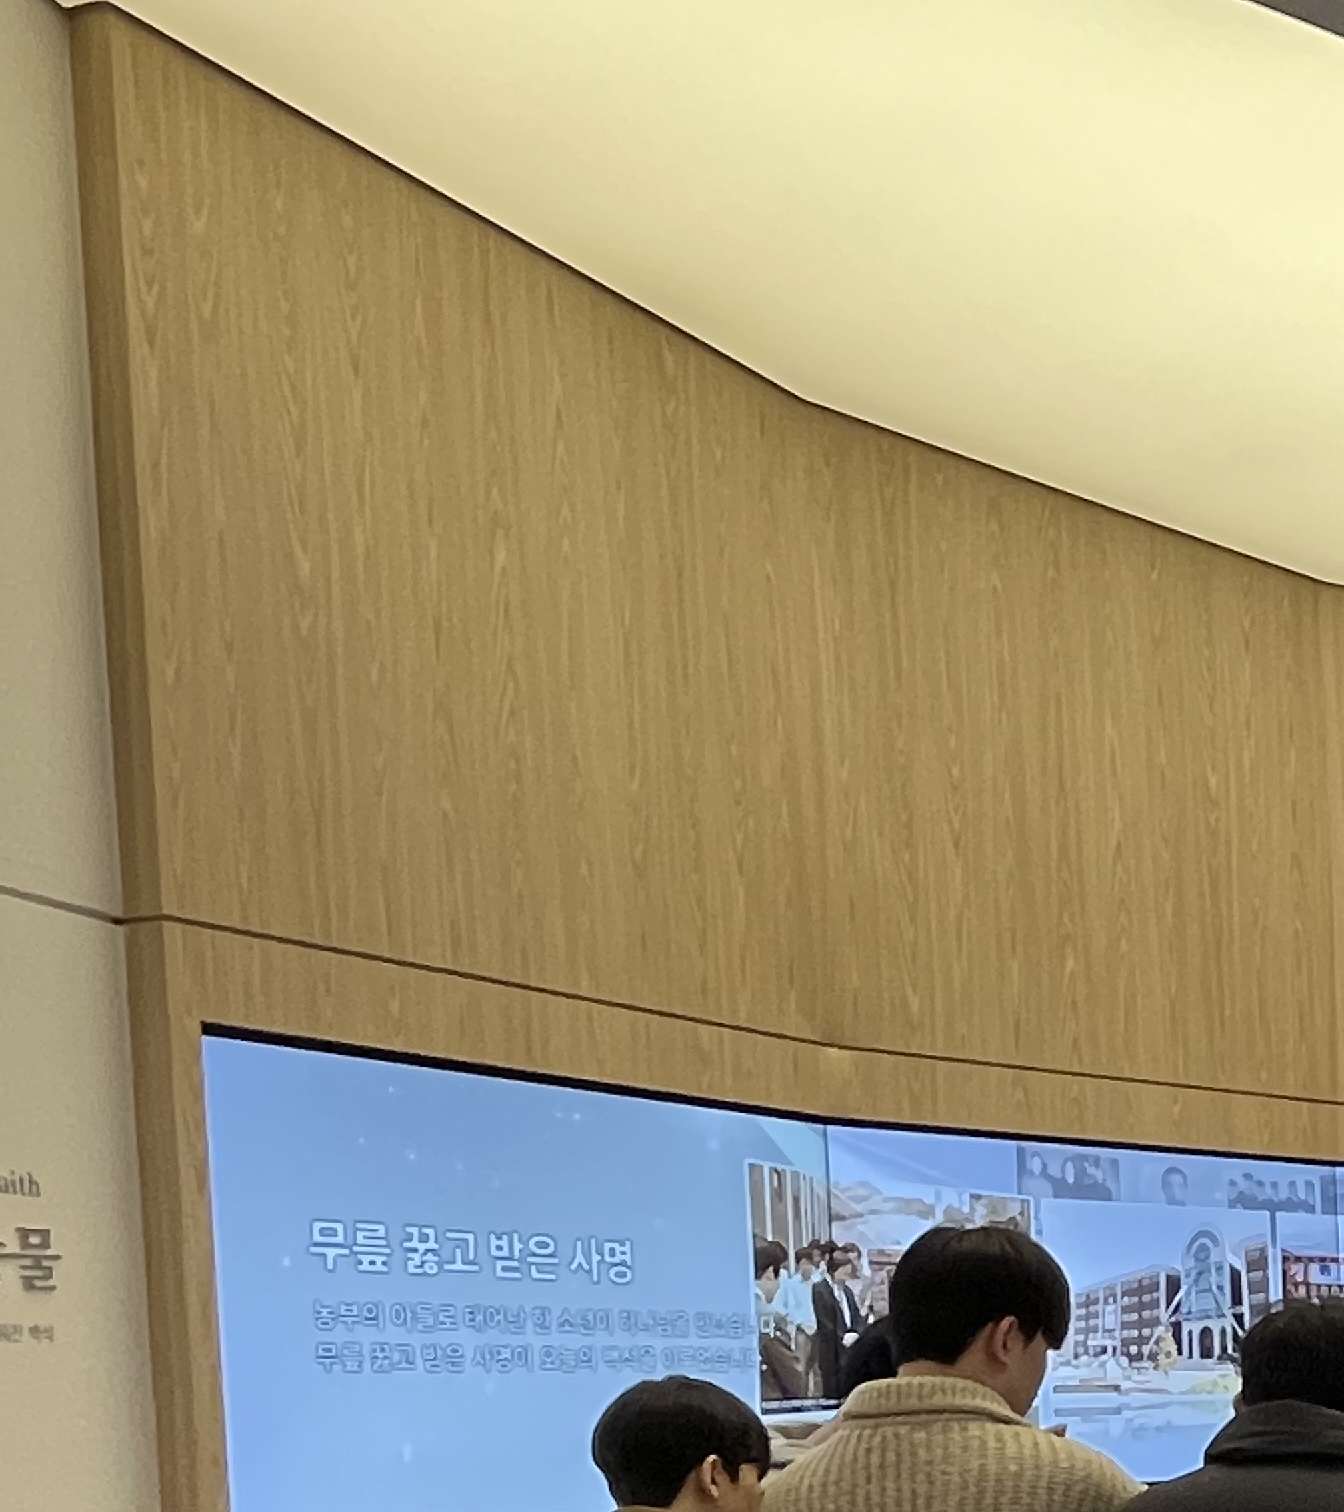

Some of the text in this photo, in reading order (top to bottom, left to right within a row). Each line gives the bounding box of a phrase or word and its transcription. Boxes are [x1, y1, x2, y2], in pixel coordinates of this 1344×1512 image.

[309, 1219, 634, 1285] 무릎 꿇고 받은 사명
[314, 1299, 385, 1332] 농부의
[390, 1301, 459, 1333] 아들로
[463, 1304, 527, 1335] 태어난
[531, 1306, 551, 1336] 한
[557, 1307, 615, 1337] 소년이
[315, 1341, 364, 1373] 무릎
[370, 1341, 417, 1373] 꿇고
[421, 1343, 466, 1373] 받은
[471, 1343, 535, 1374] 사명이
[538, 1344, 598, 1374] 오늘의
